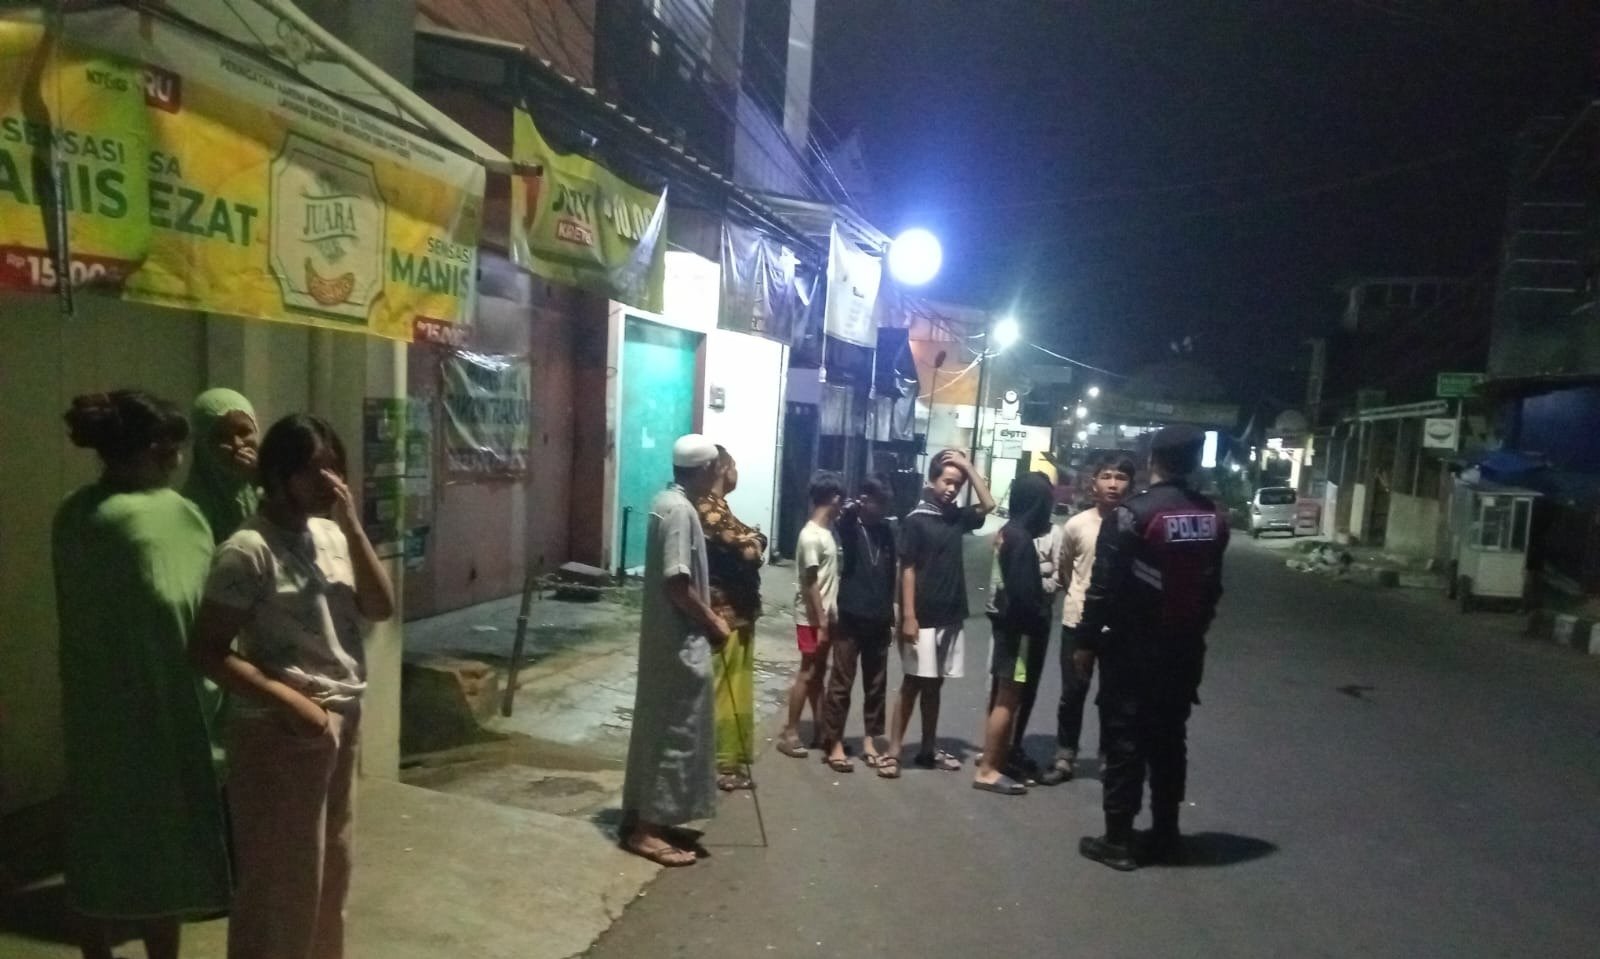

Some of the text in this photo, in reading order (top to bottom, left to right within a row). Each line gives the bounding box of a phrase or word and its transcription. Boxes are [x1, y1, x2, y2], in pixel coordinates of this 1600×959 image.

[303, 202, 357, 235] JUARA
[391, 247, 470, 299] MANIS
[1166, 516, 1217, 540] POLISI
